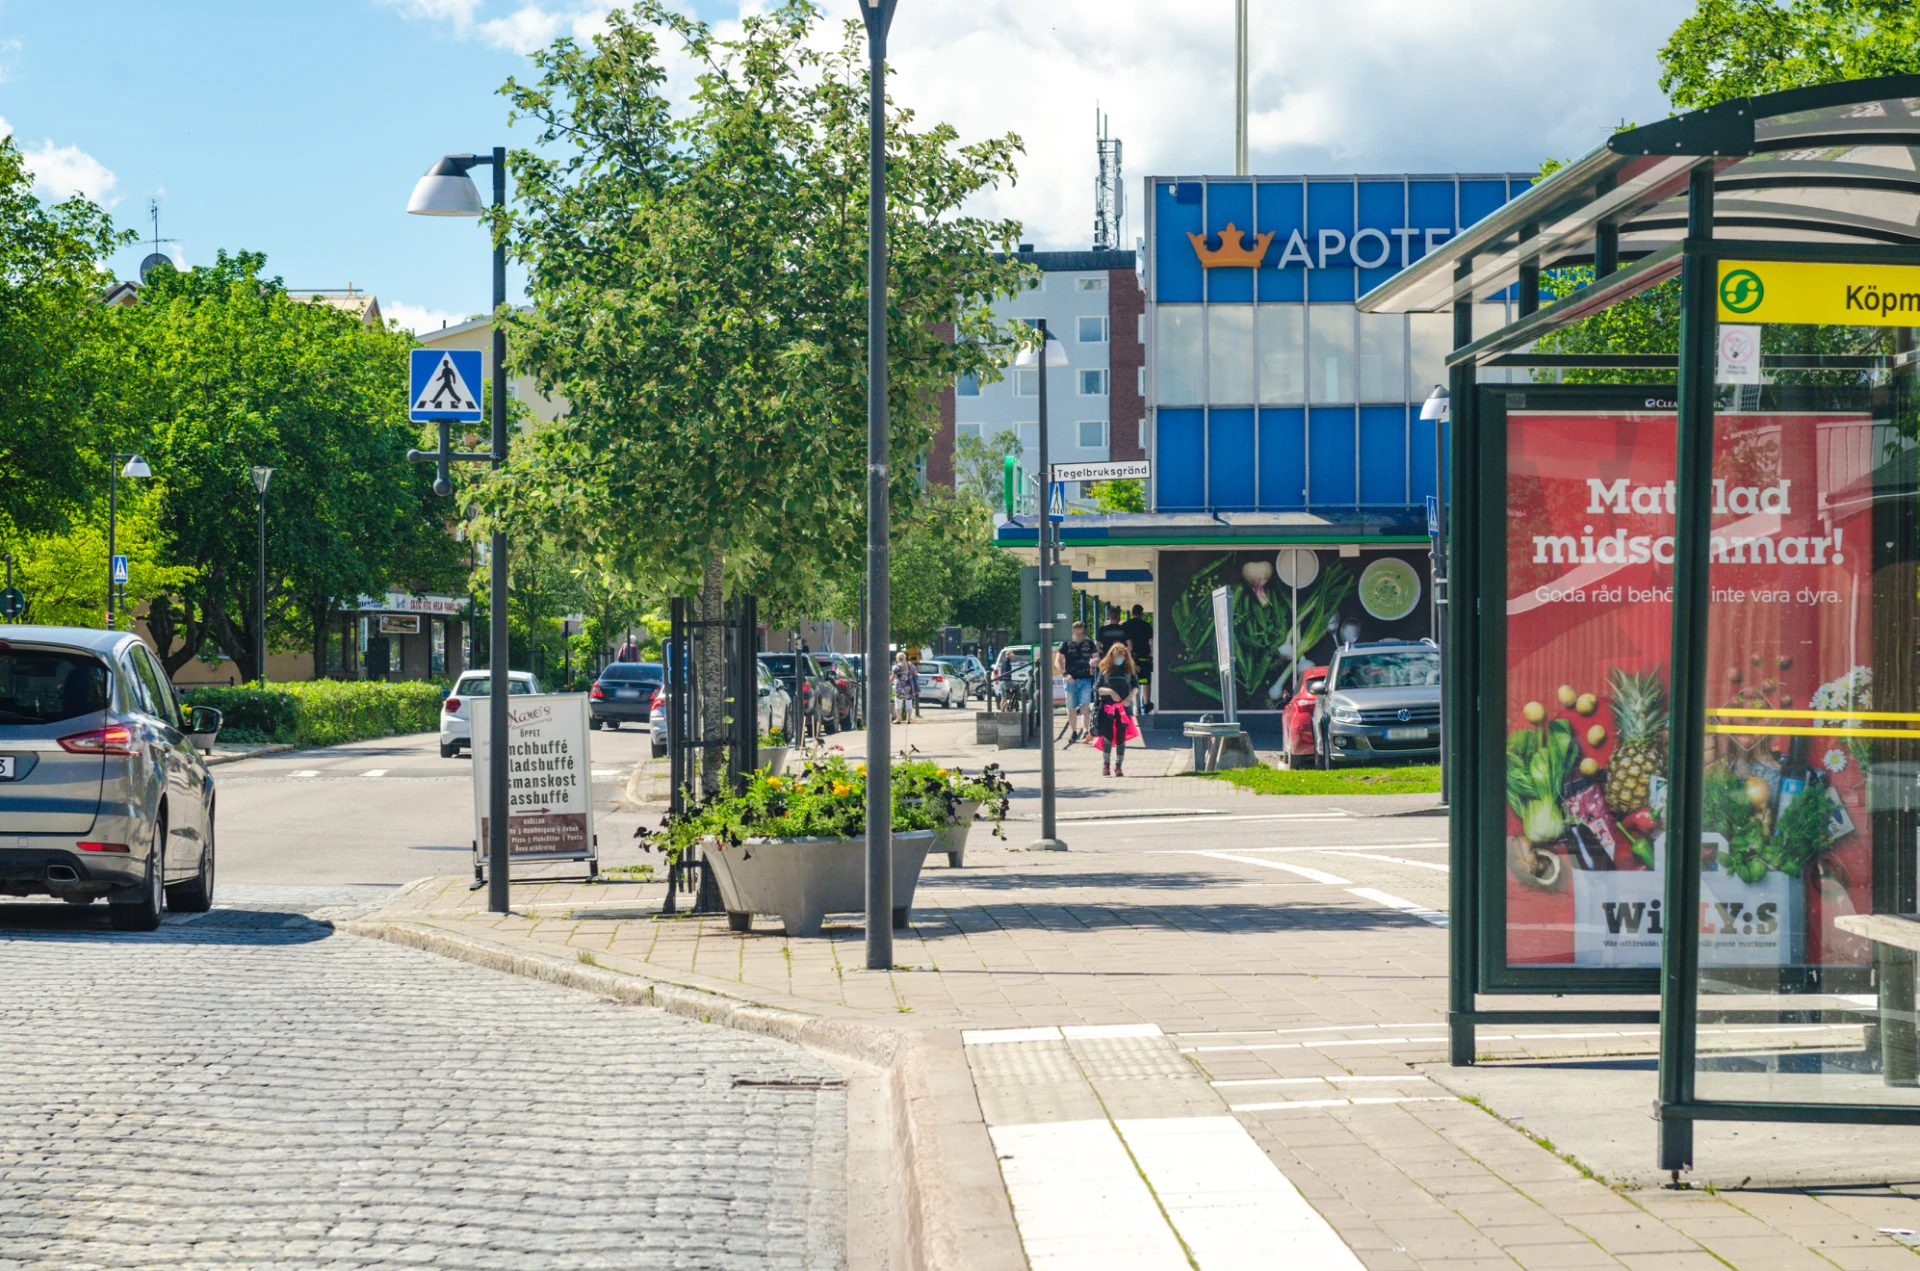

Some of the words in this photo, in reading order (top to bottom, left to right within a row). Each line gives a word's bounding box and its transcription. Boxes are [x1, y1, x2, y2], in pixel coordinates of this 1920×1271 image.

[1277, 228, 1465, 269] APOTE
[1656, 399, 1678, 409] CLEA
[1057, 465, 1147, 479] Tegelbruksgränd
[1586, 478, 1791, 515] Matlad
[1533, 525, 1845, 565] midsomar!
[1535, 585, 1586, 603] Goda
[1592, 584, 1621, 603] råd
[1628, 584, 1674, 603] behö
[1711, 586, 1746, 604] inte
[1750, 590, 1790, 603] vara
[1796, 585, 1842, 608] dyra.
[519, 728, 541, 738] ÖPPET
[508, 739, 568, 756] nchbuffé
[509, 756, 574, 772] ladsbuffé
[508, 773, 577, 788] smanskost
[509, 789, 569, 806] assbuffé
[1602, 899, 1778, 935] WiLY:S
